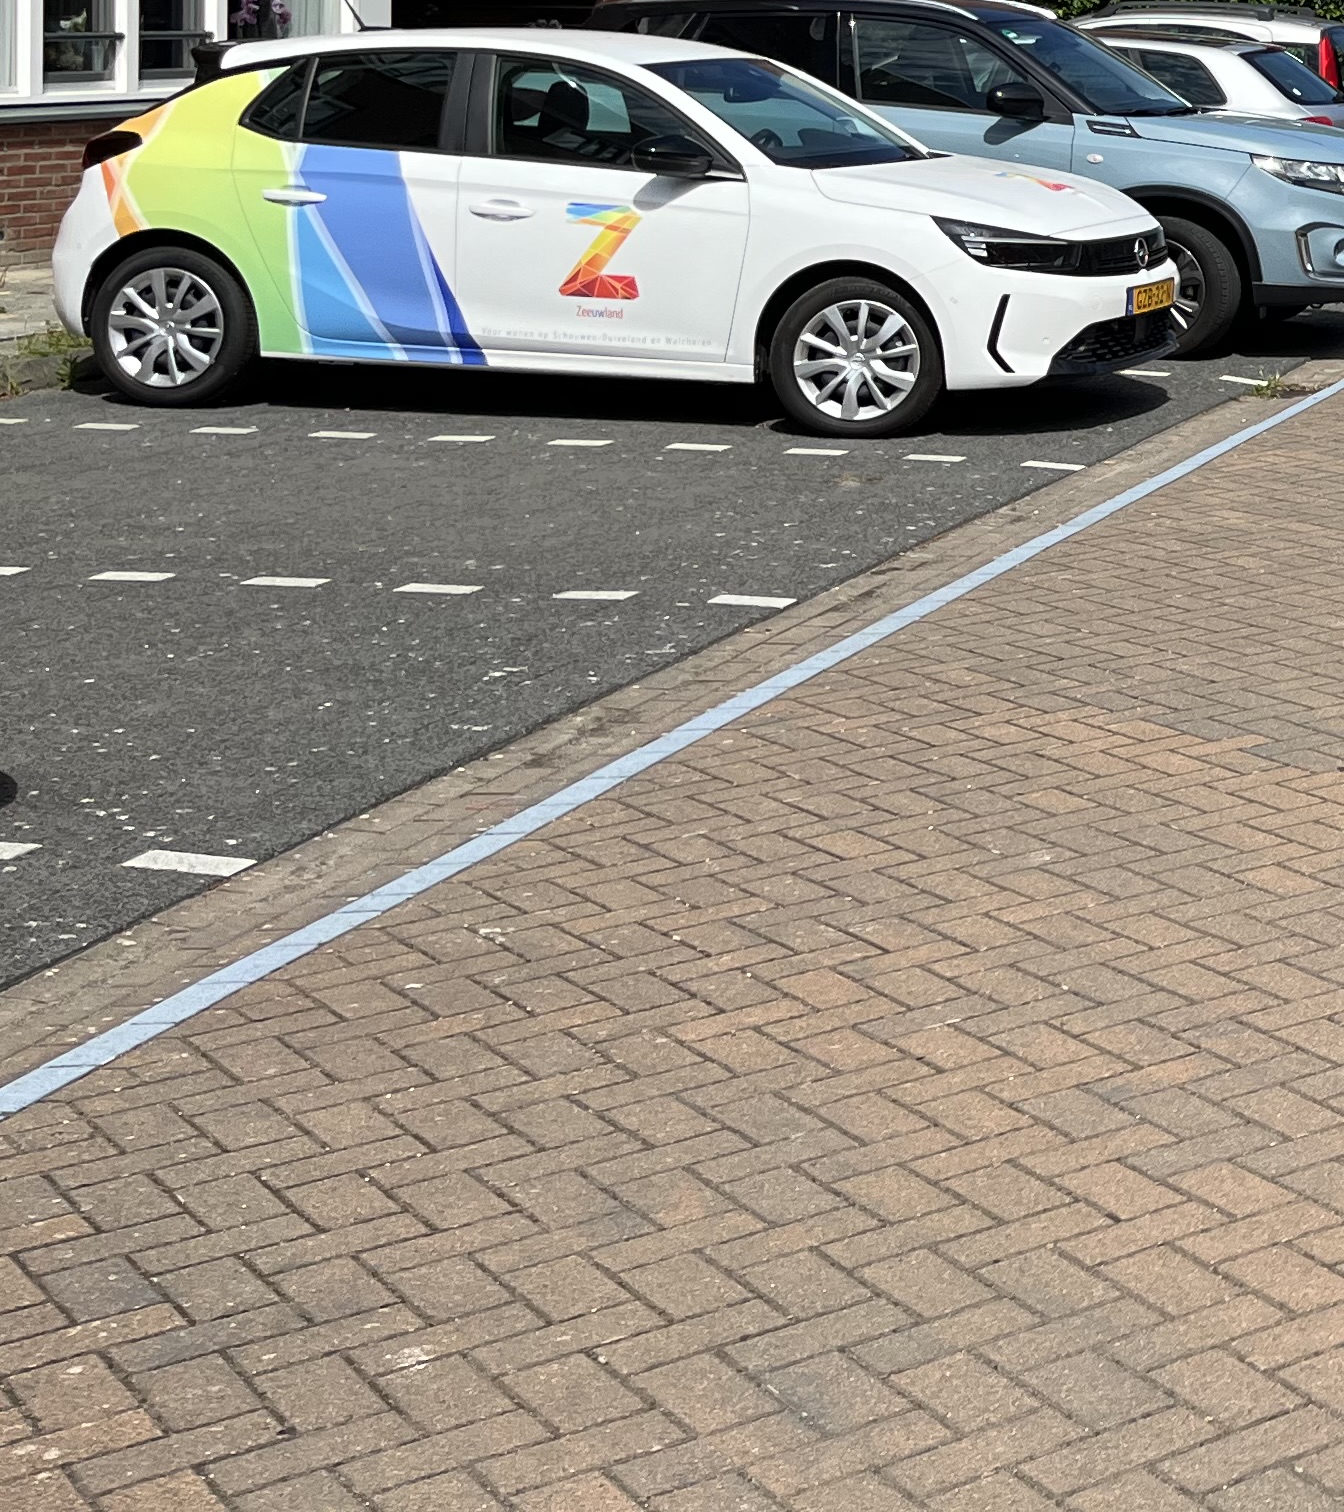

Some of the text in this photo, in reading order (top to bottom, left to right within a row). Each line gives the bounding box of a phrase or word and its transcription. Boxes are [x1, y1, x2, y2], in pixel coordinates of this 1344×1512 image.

[576, 305, 624, 319] Zeeuwland
[481, 327, 502, 336] Voor
[506, 329, 534, 338] wonen
[538, 331, 549, 340] op
[650, 336, 661, 344] en
[665, 336, 712, 346] Walcheren
